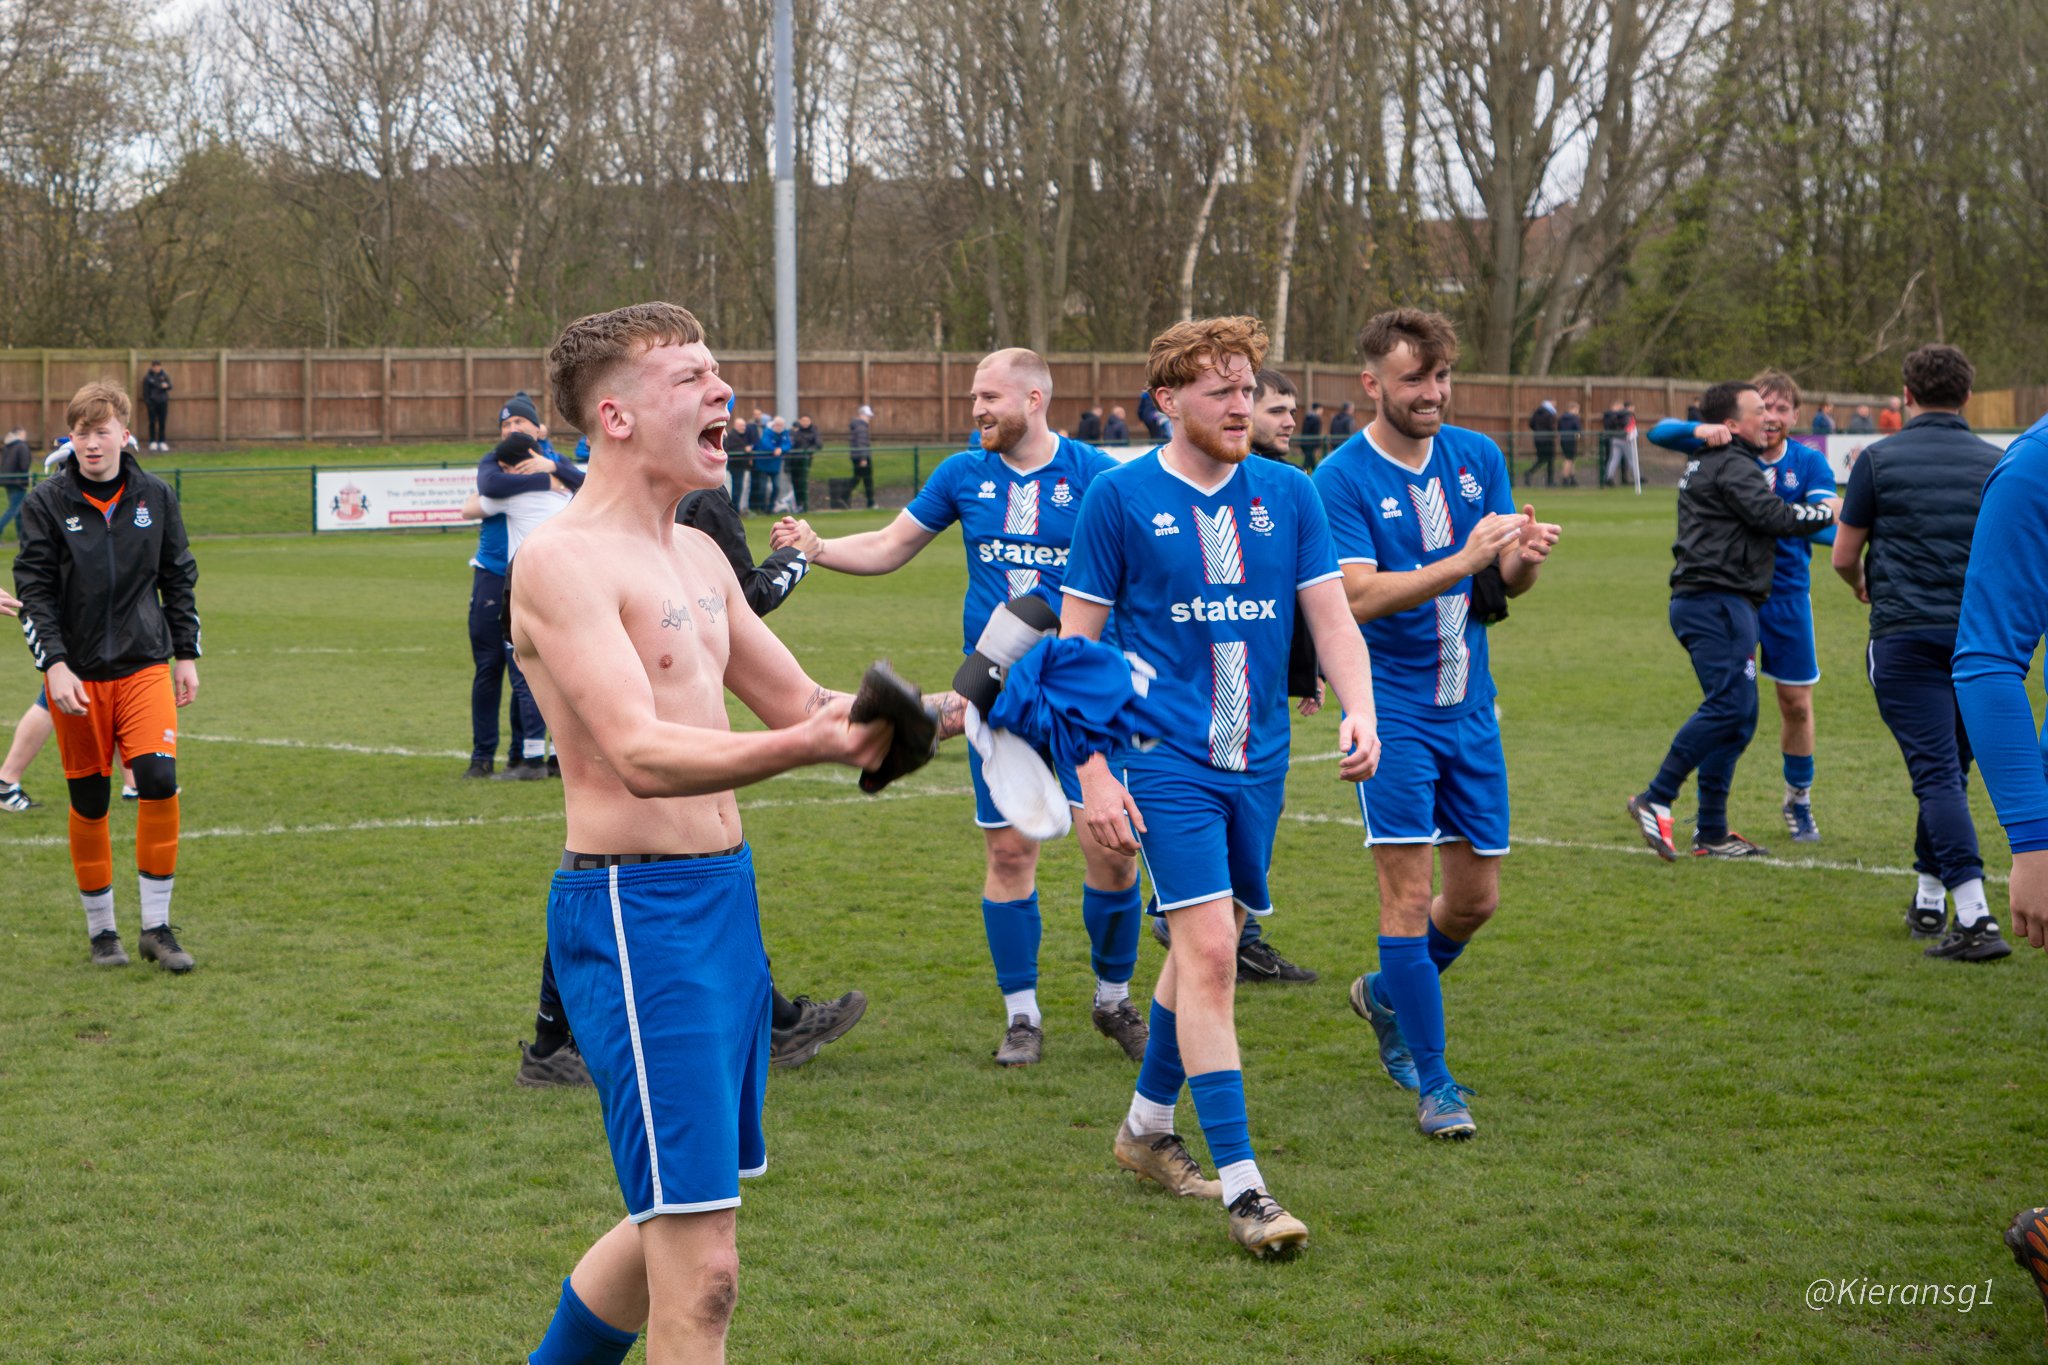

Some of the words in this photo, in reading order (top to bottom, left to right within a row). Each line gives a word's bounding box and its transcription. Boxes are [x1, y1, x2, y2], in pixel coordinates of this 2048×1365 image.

[420, 498, 448, 506] London
[391, 512, 424, 522] PROUD
[979, 539, 1070, 567] statex
[1170, 594, 1277, 623] statex
